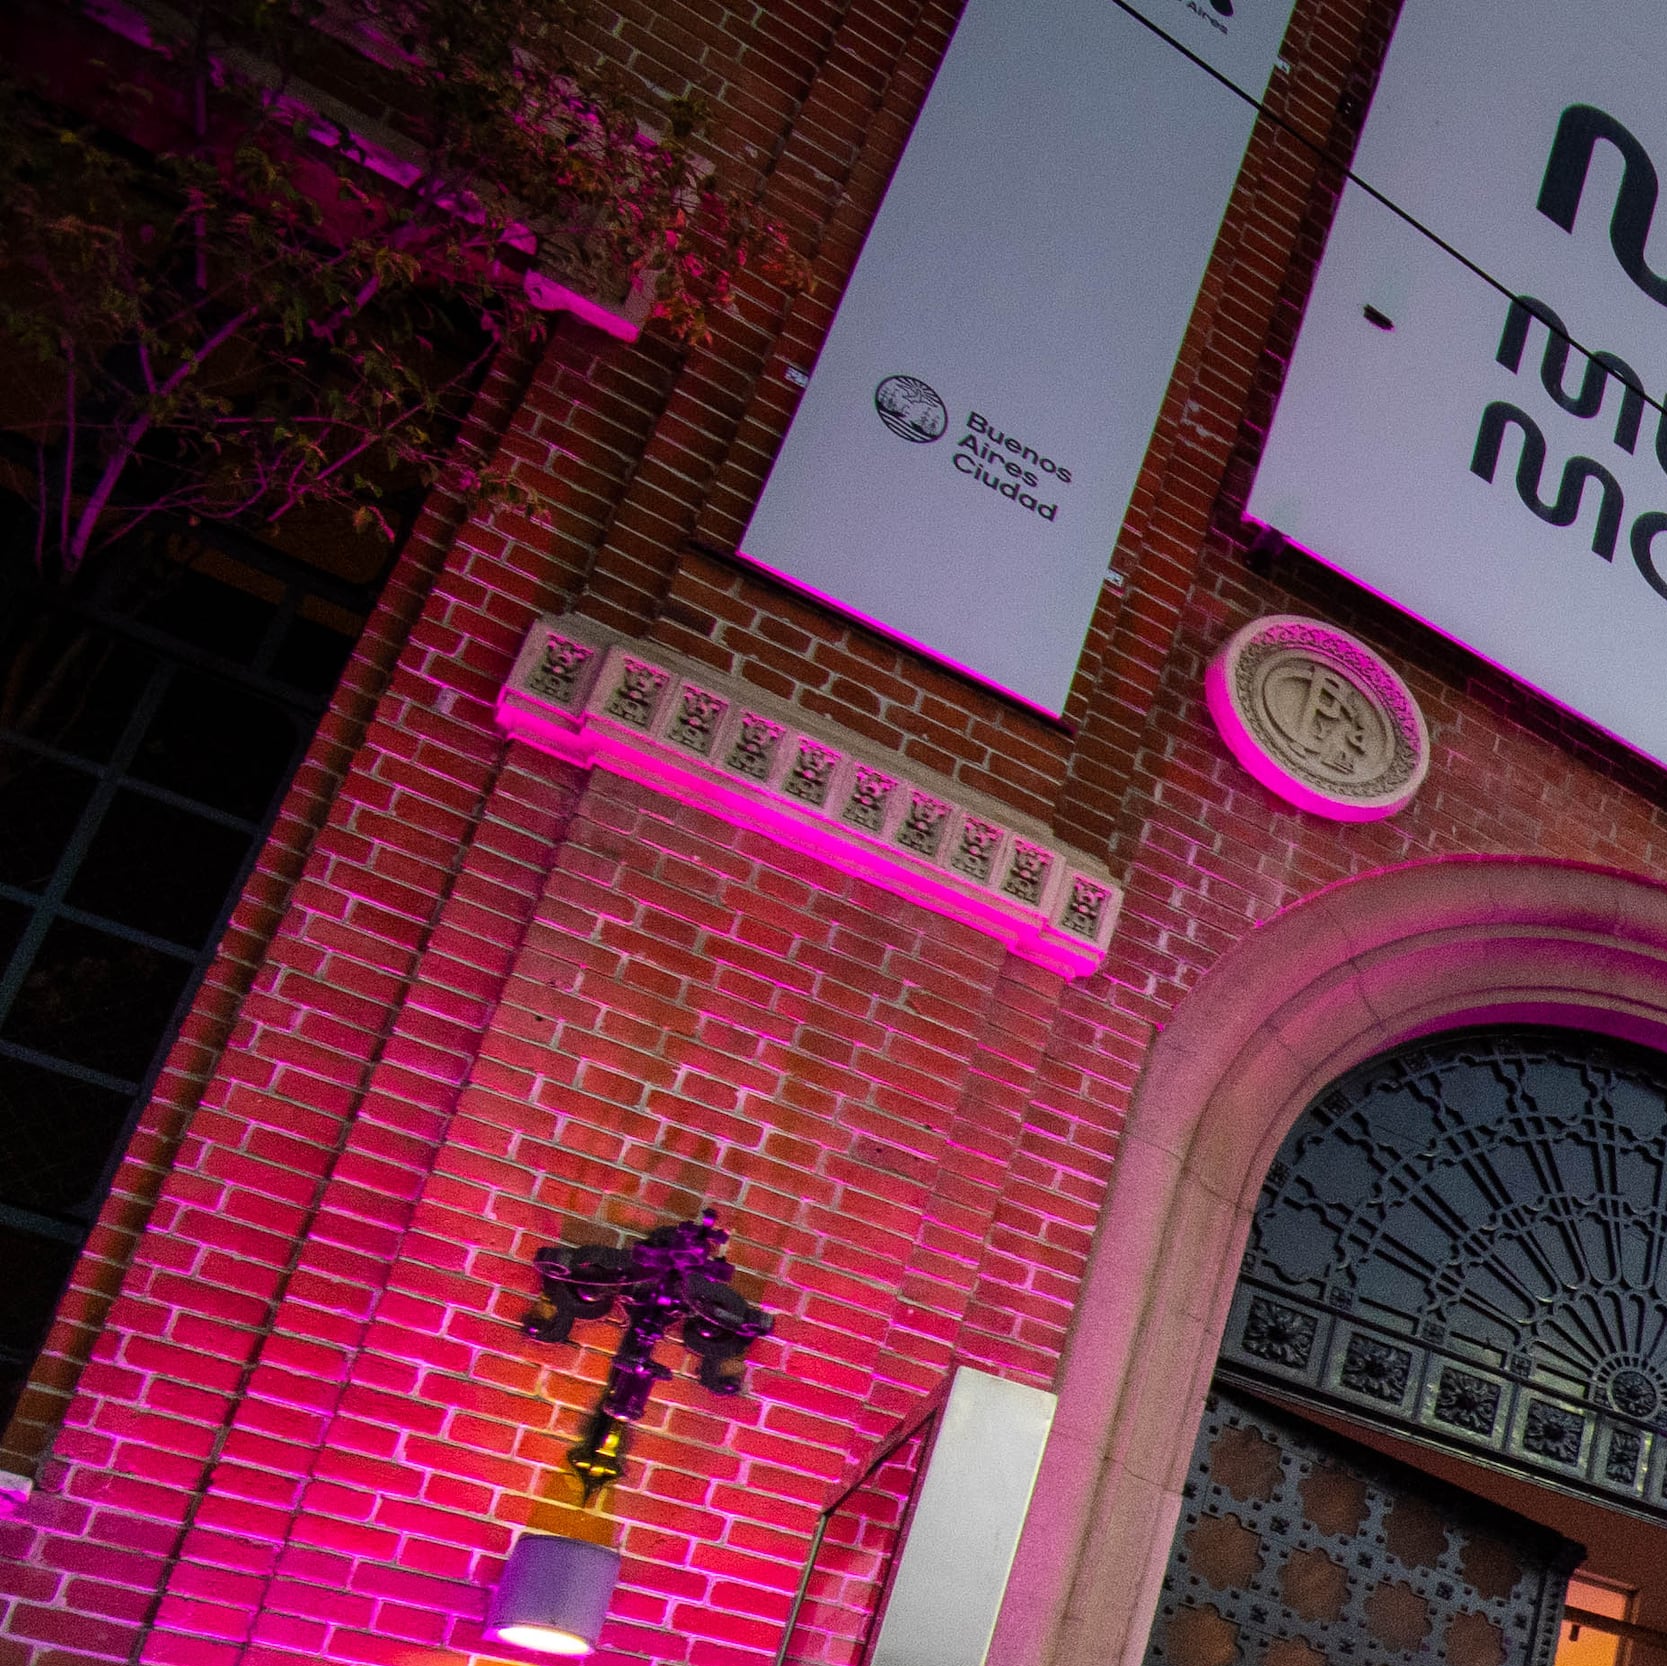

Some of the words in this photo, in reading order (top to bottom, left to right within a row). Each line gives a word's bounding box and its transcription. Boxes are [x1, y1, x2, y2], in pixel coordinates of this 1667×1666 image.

[957, 433, 1038, 488] Aires
[966, 411, 1072, 484] Buenos
[952, 452, 1059, 522] Ciudad
